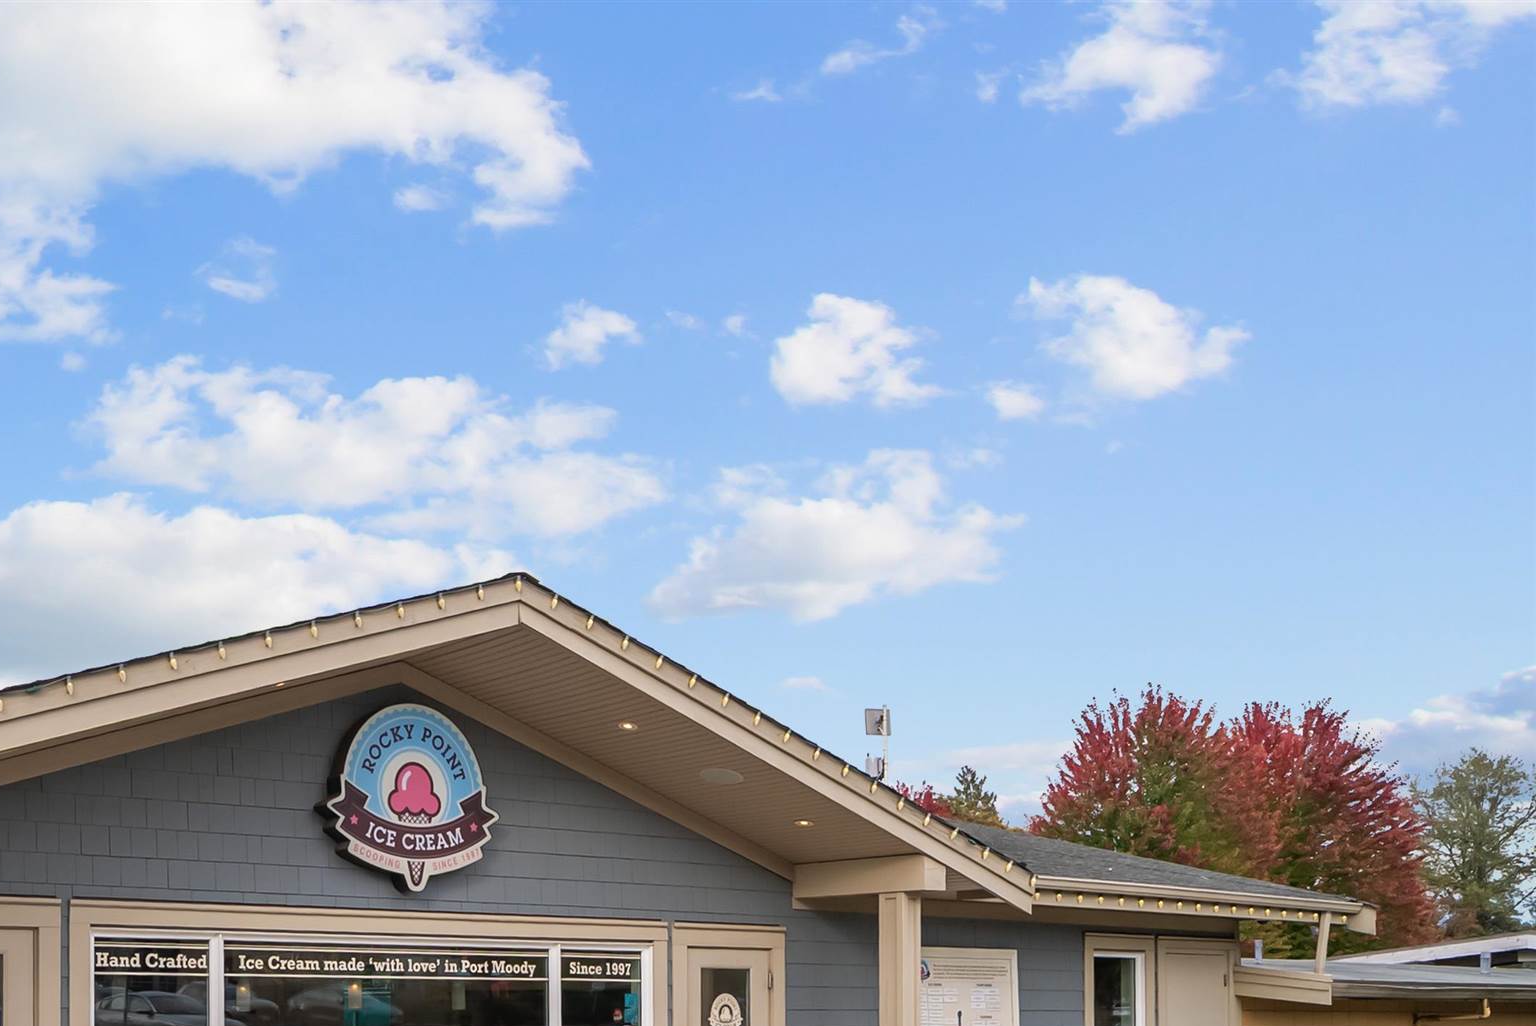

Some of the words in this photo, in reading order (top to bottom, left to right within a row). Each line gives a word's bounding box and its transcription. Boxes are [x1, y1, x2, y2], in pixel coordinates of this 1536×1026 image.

[362, 724, 414, 774] ROCKY
[421, 727, 466, 781] POINT
[365, 822, 397, 847] ICE
[402, 828, 464, 851] CREAM
[353, 843, 401, 869] SCOOPING
[432, 860, 458, 871] SINCE
[95, 952, 141, 968] Hand
[145, 953, 207, 969] Crafted
[238, 955, 264, 970] Ice
[268, 956, 320, 971] Cream
[323, 956, 364, 972] made
[444, 959, 458, 974] in
[461, 960, 489, 974] Port
[491, 960, 536, 977] Moody
[569, 962, 602, 975] Since
[605, 962, 632, 976] 1997
